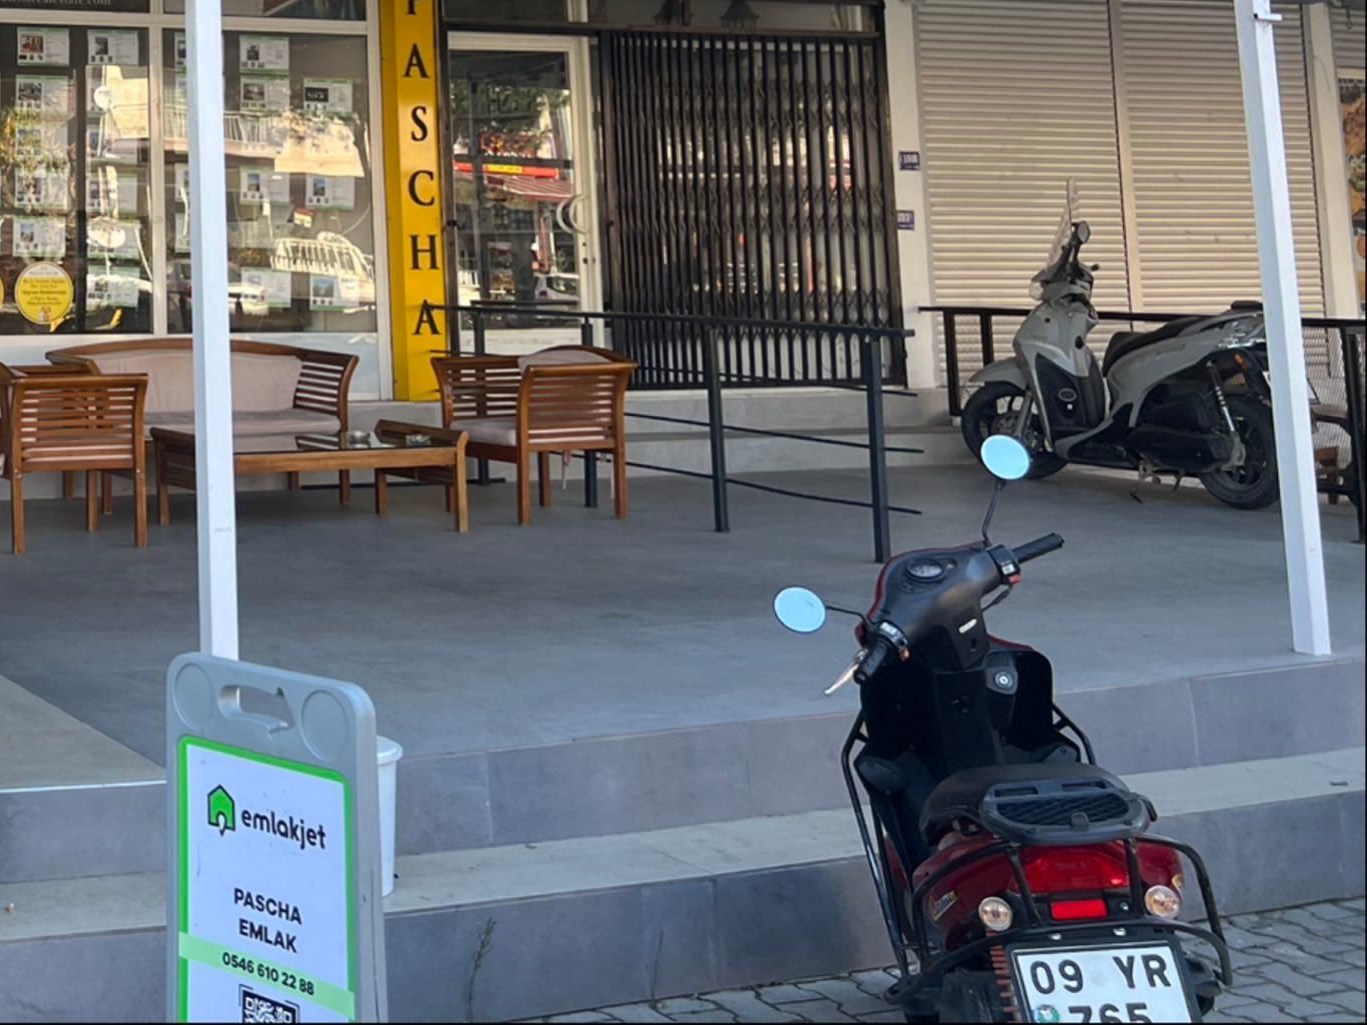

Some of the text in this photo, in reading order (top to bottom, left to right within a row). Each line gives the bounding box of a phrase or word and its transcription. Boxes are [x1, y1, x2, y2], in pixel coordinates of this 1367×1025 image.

[241, 809, 327, 850] emlakjet
[234, 887, 302, 925] PASCHA
[239, 918, 298, 954] EMLAK
[222, 952, 315, 996] 0546 610 22 88
[1030, 954, 1172, 995] 09 YR
